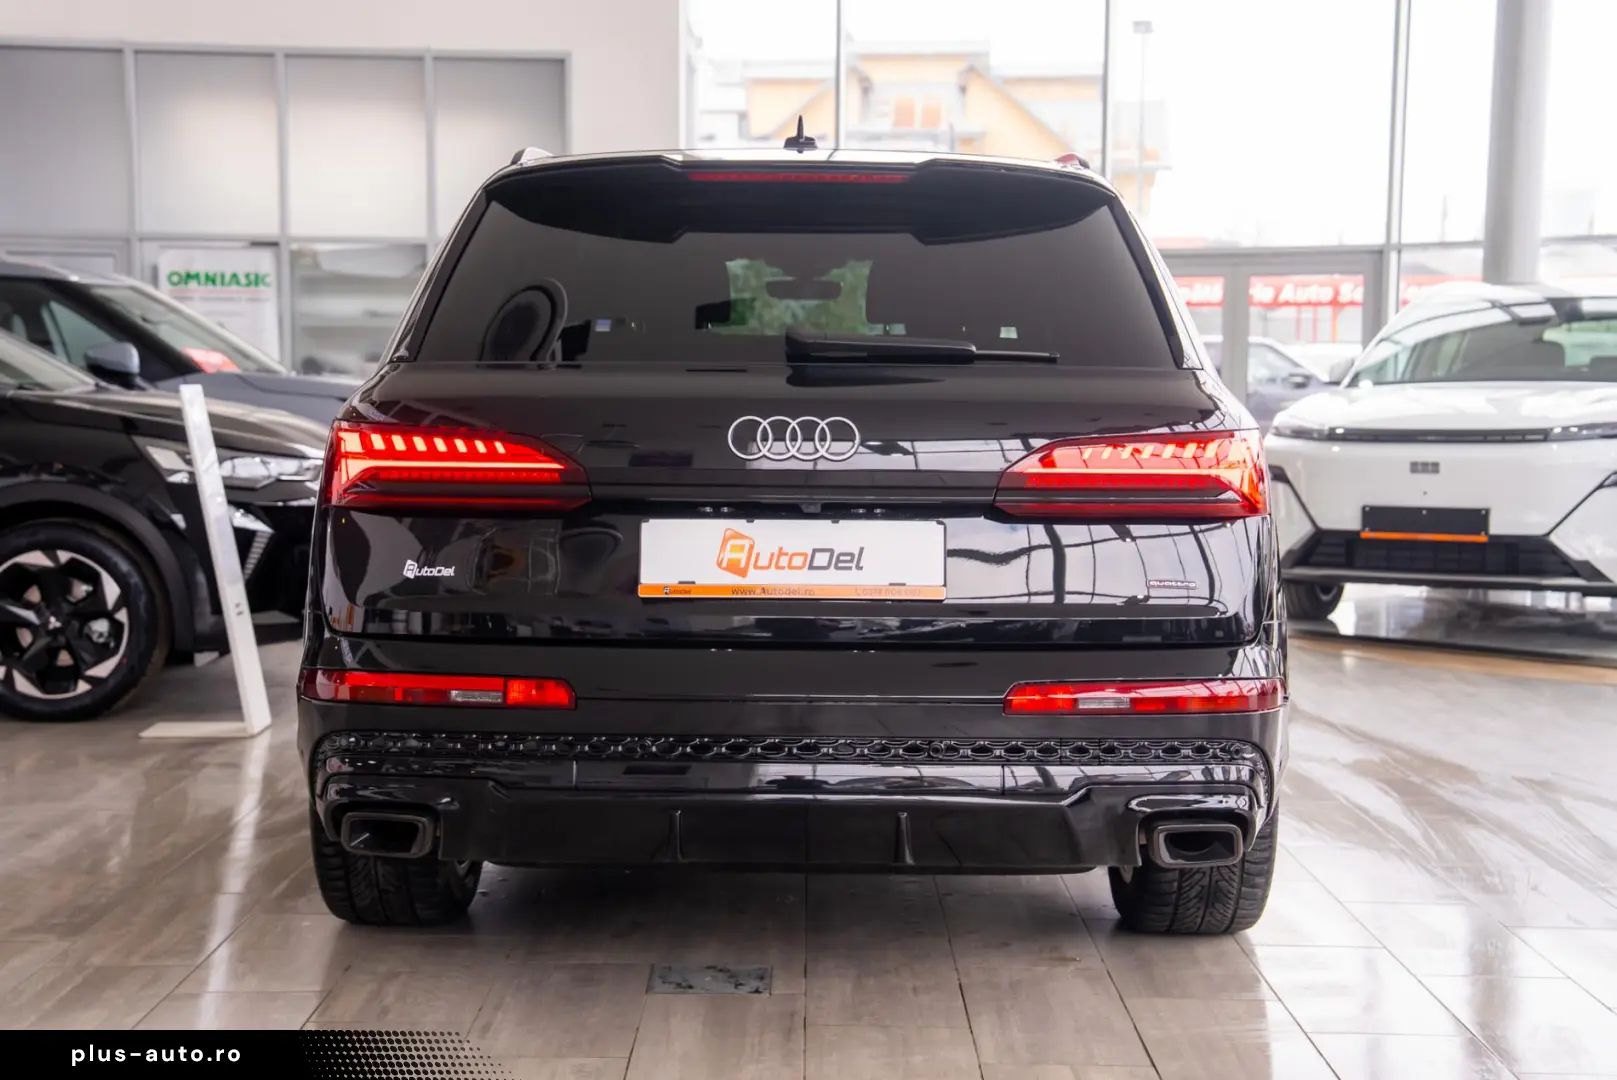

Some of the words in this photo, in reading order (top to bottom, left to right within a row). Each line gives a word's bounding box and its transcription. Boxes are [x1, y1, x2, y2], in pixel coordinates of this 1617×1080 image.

[1278, 282, 1333, 303] Auto
[716, 527, 865, 578] AutoDel
[403, 559, 455, 579] AutoDel
